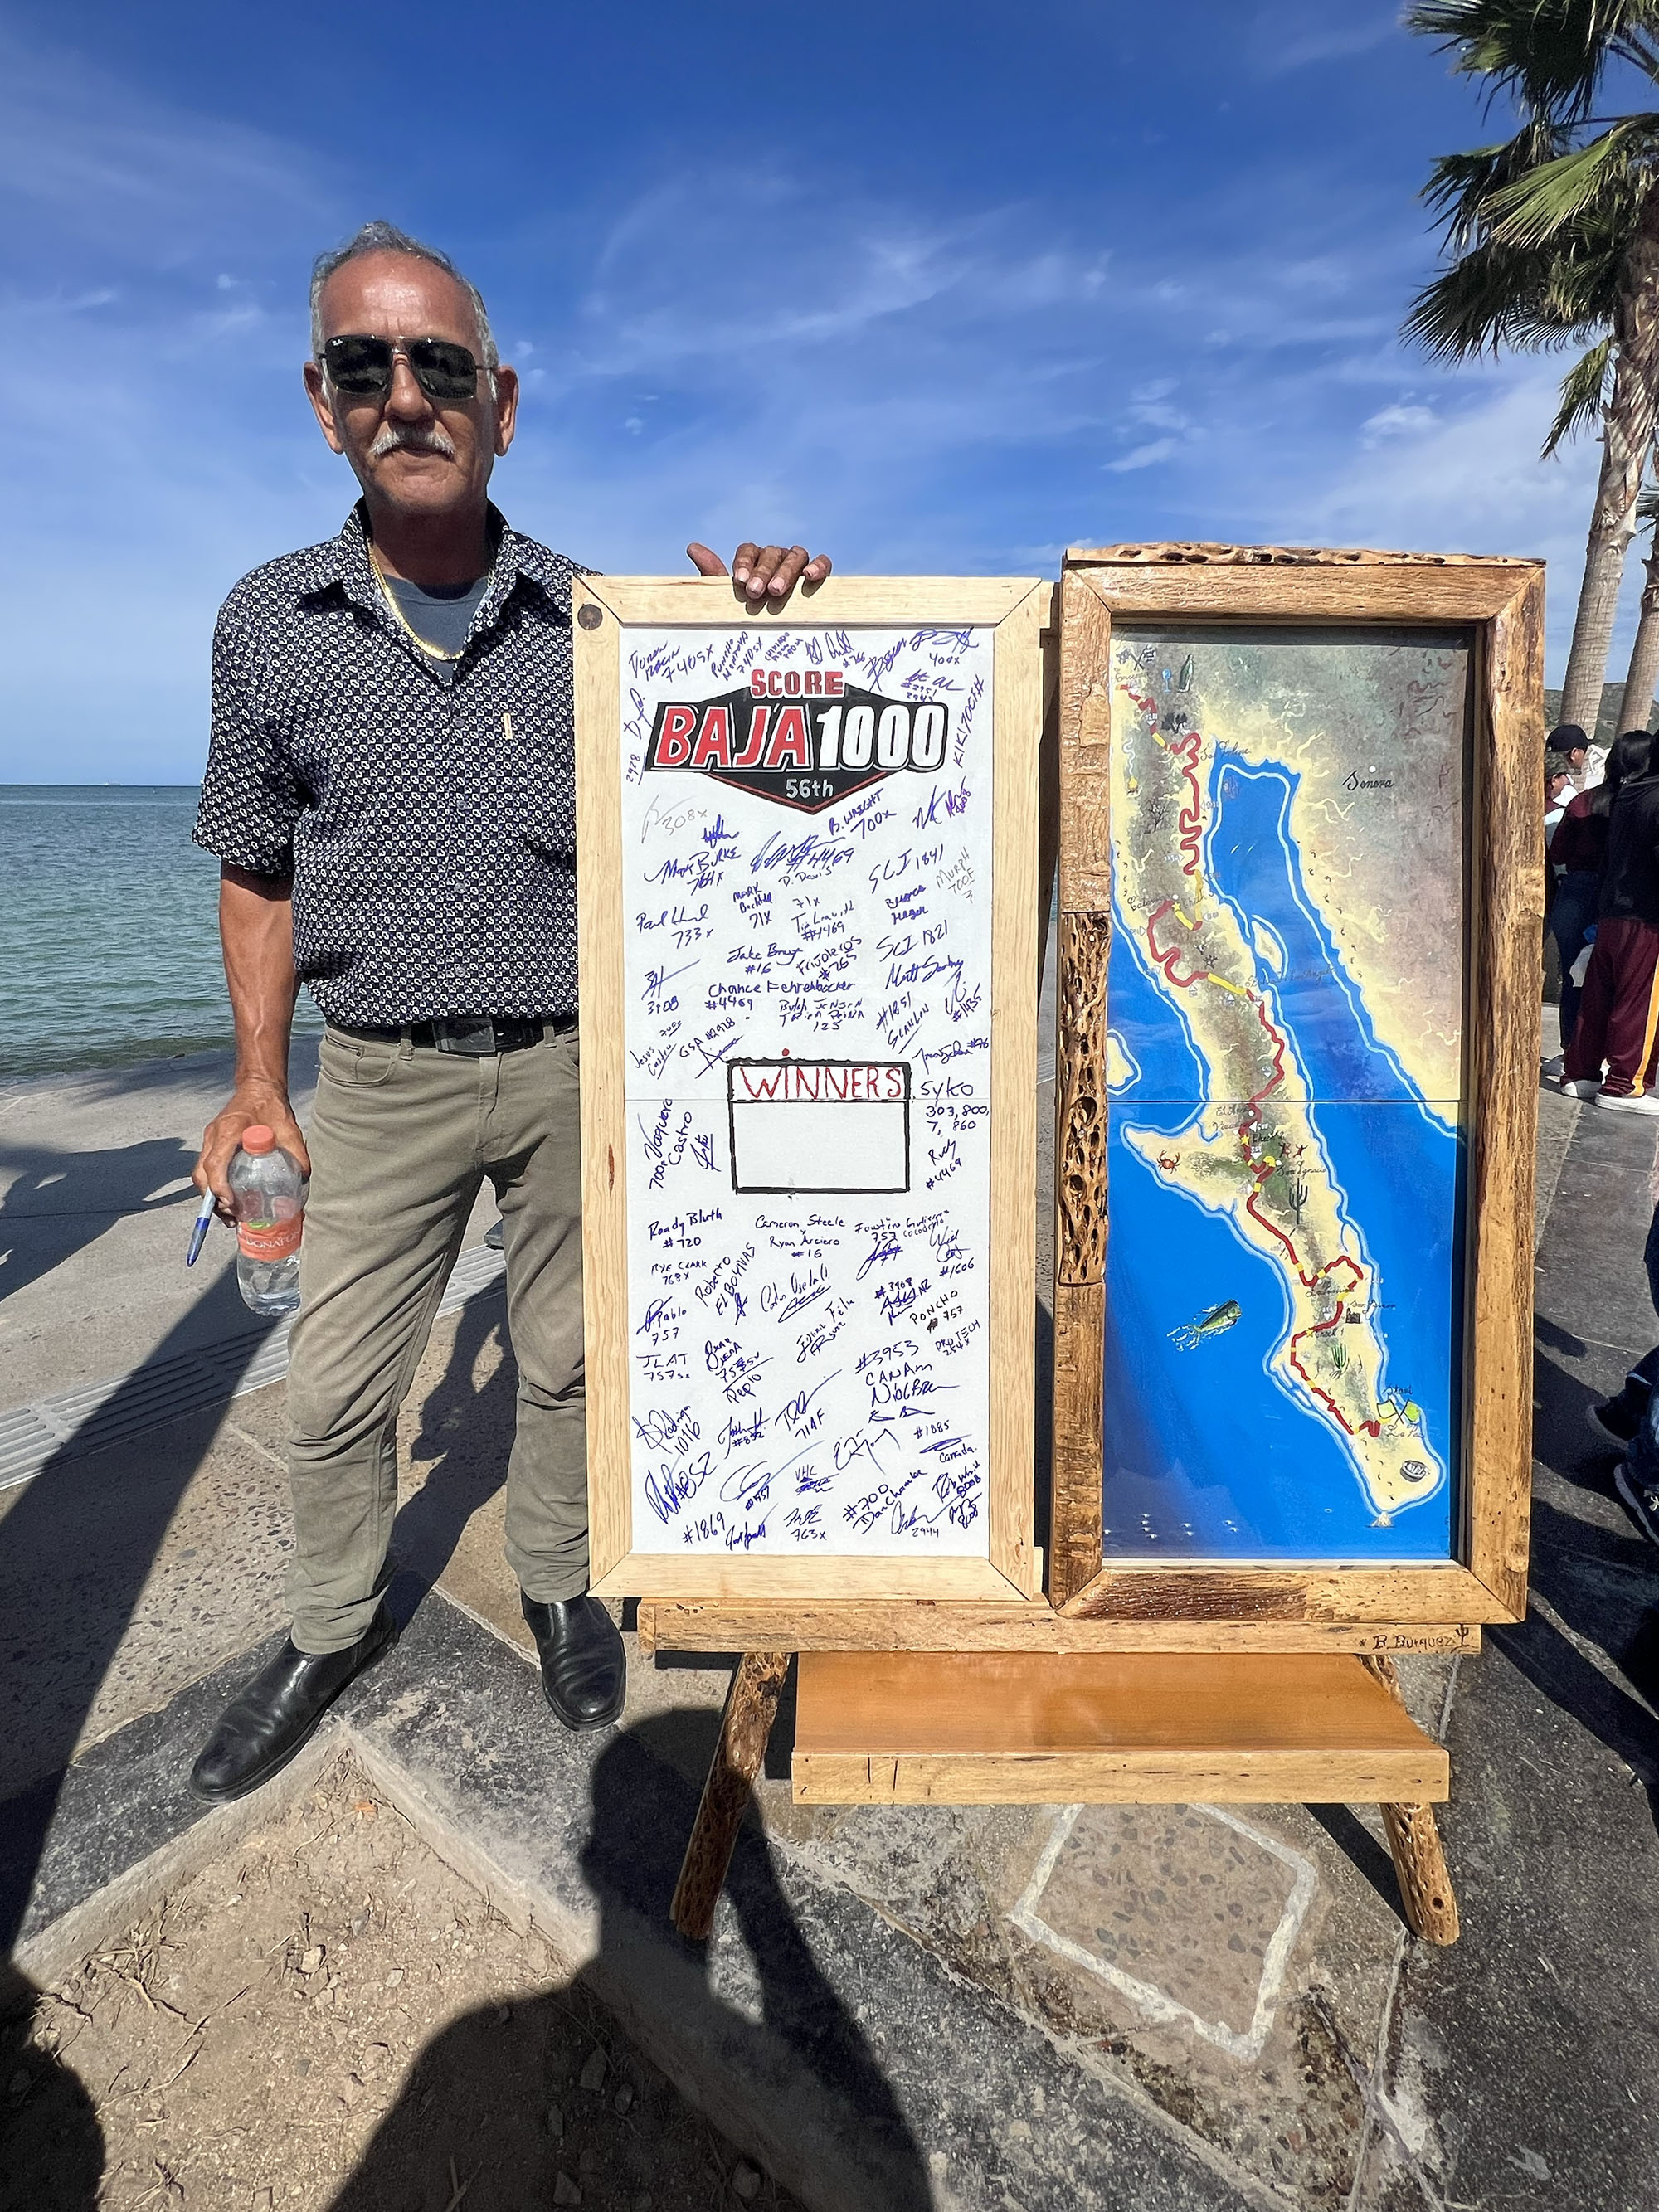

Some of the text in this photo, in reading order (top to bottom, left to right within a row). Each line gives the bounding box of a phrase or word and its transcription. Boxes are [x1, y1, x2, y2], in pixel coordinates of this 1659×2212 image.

[752, 668, 844, 697] SCORE
[654, 704, 812, 768] BAJA
[816, 705, 945, 771] 1000
[786, 779, 834, 799] 56th
[708, 982, 761, 998] Chance
[739, 1065, 902, 1100] WINNERS
[952, 1120, 976, 1131] 860
[755, 1214, 845, 1229] Cameron Steele
